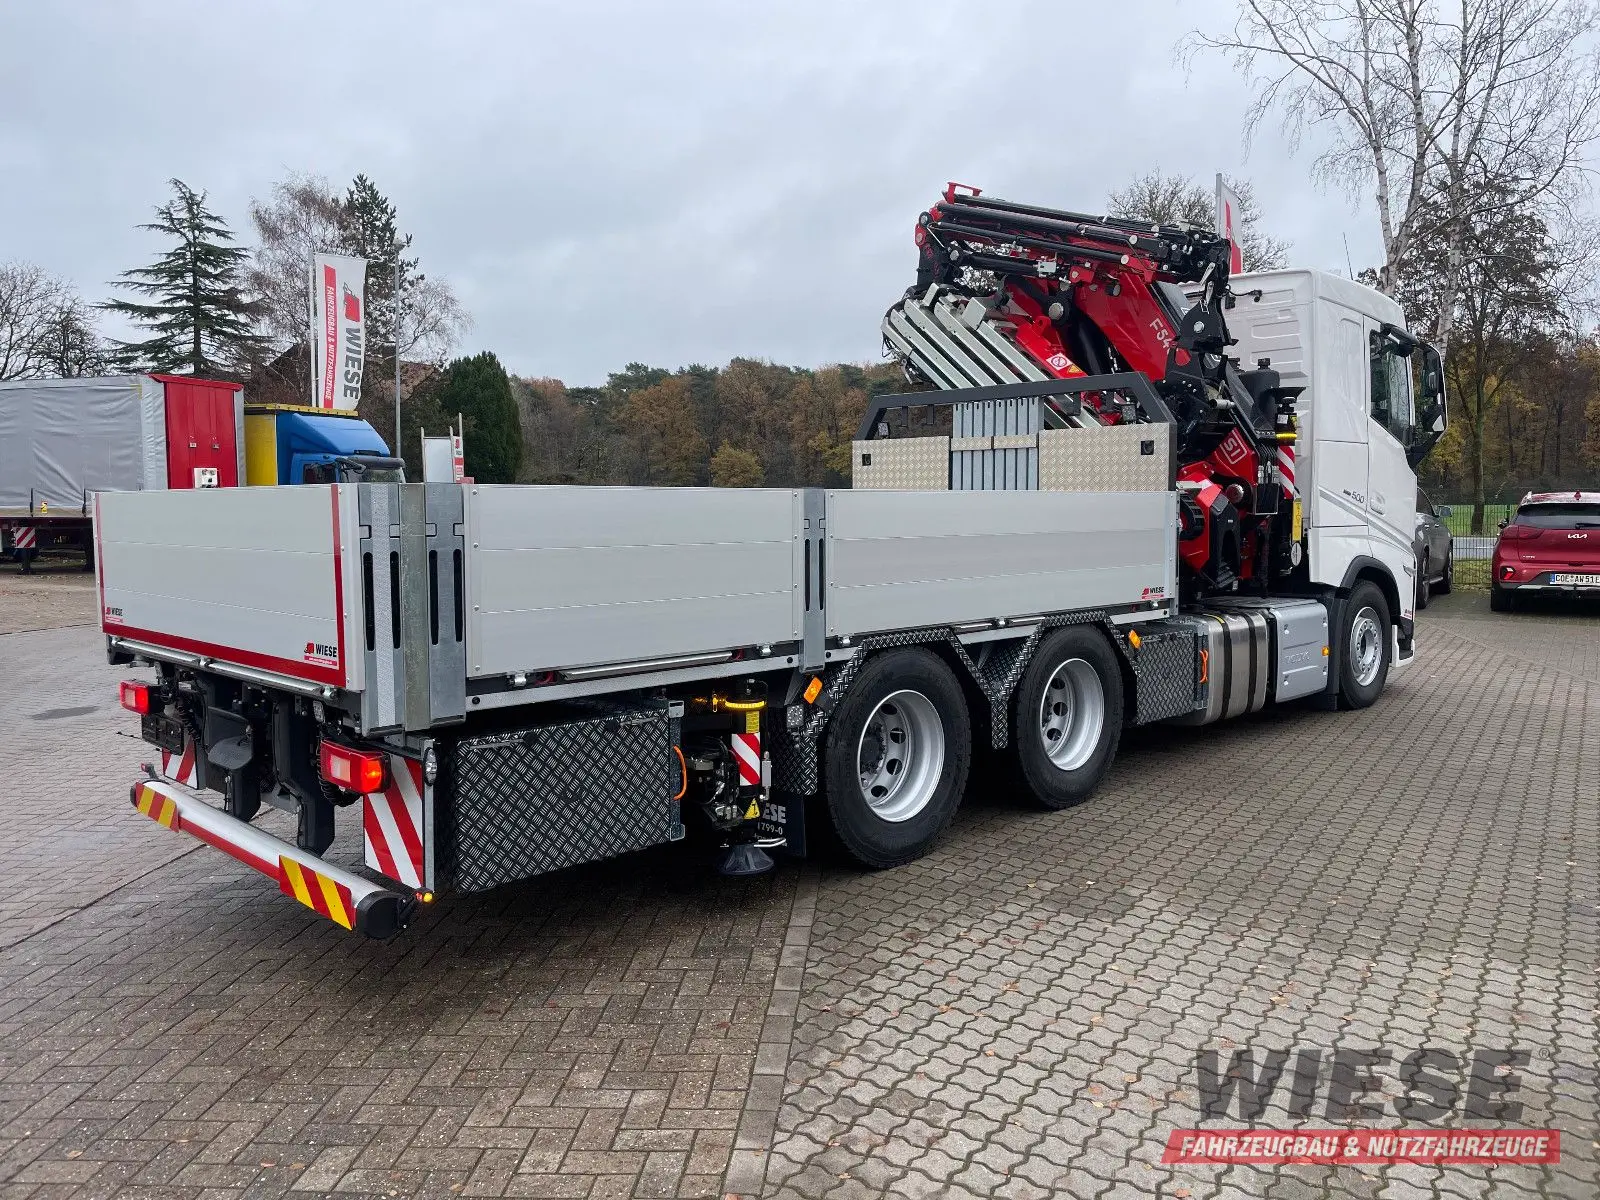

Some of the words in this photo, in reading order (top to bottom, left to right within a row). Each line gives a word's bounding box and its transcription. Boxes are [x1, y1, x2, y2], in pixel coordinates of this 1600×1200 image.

[326, 286, 335, 336] FAHRZEUGBAU
[325, 344, 335, 401] NUTZFAHRZEUGE
[343, 327, 362, 400] WIESE
[1351, 491, 1365, 504] 500
[315, 643, 338, 657] WIESE
[763, 802, 787, 824] ESE
